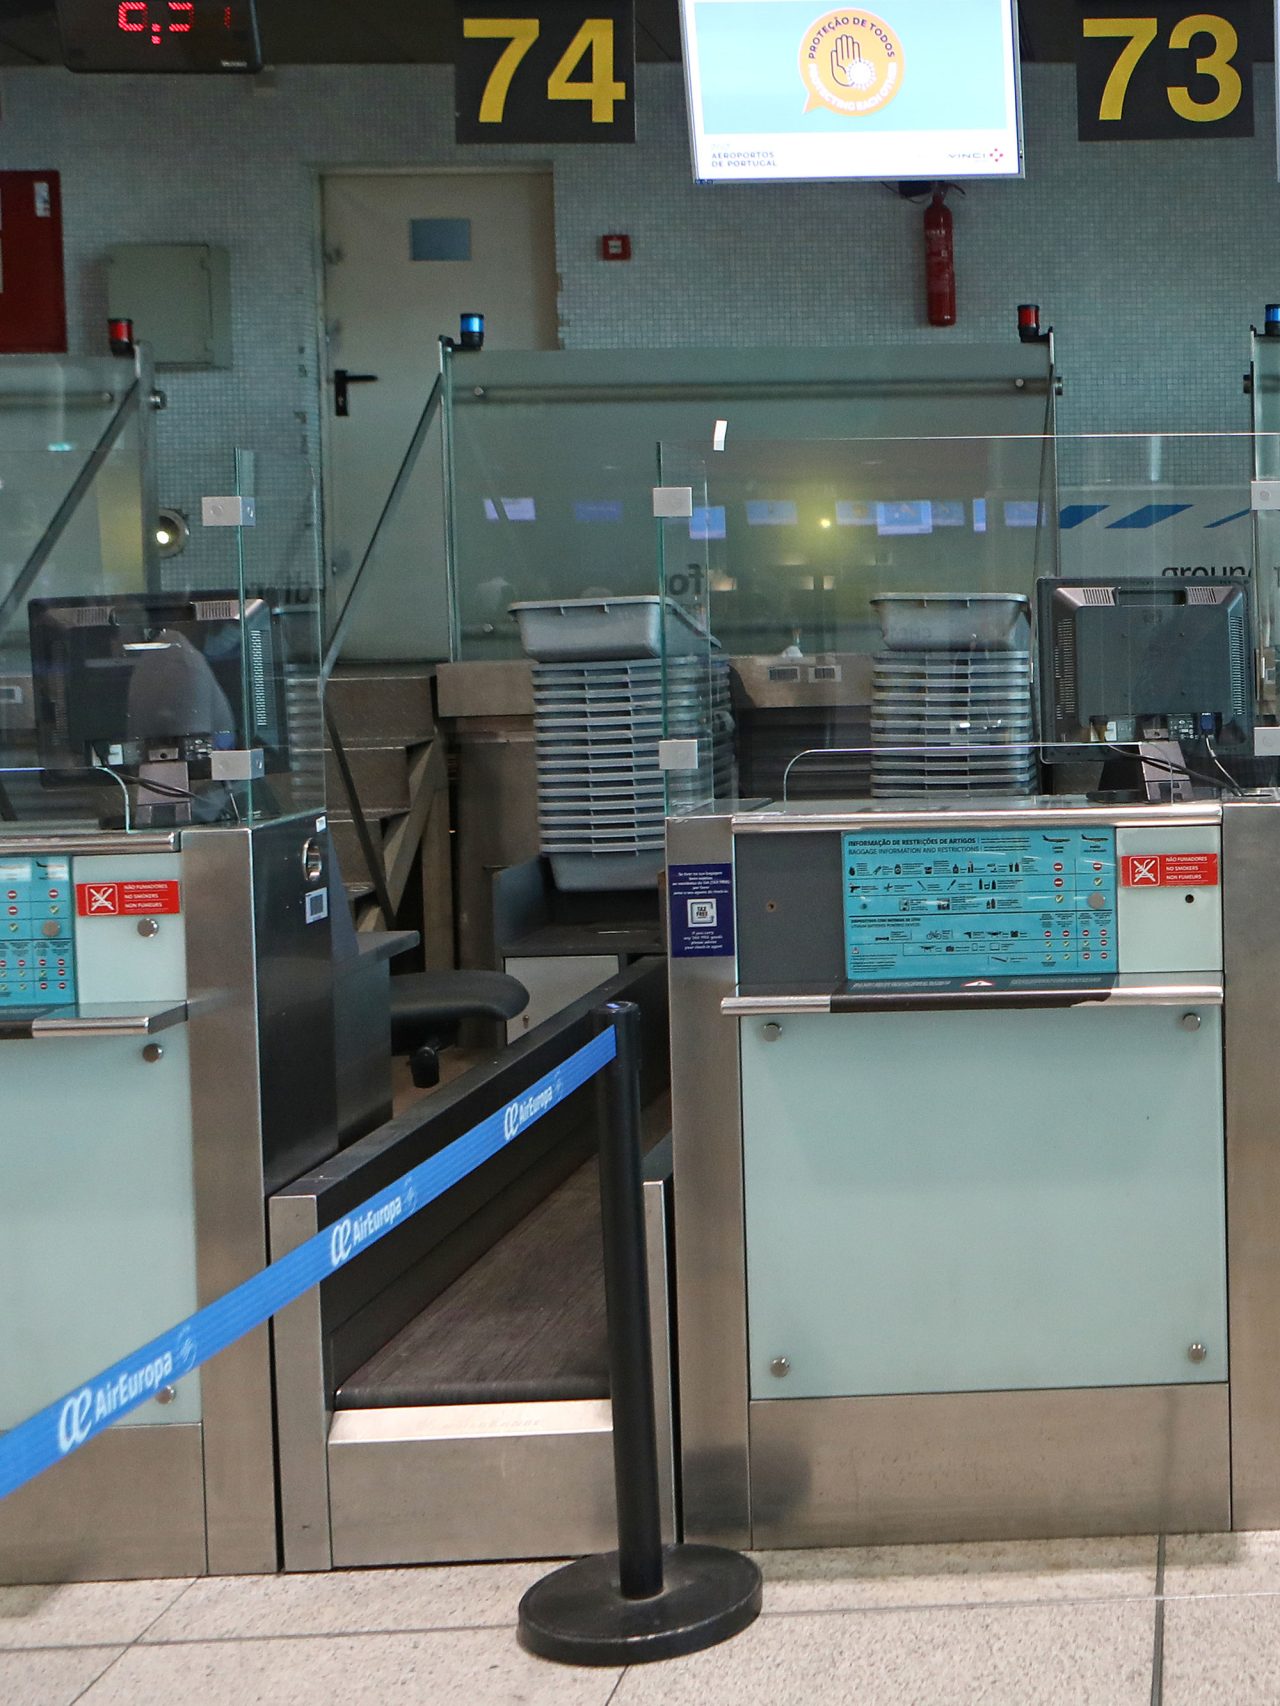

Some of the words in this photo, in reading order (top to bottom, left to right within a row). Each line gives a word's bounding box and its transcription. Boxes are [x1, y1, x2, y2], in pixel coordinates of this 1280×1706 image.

[809, 16, 850, 59] PROTEÇÃO
[853, 17, 867, 27] DE
[869, 22, 895, 58] TODOS
[463, 17, 626, 123] 74
[1083, 14, 1243, 122] 73
[711, 151, 775, 160] AEROPORTOS
[711, 160, 723, 168] DE
[727, 159, 777, 168] PORTUGAL
[848, 838, 891, 847] INFORMAÇÃO
[519, 1085, 553, 1126] AirEuropa
[352, 1196, 402, 1247] AirEuropa
[95, 1350, 173, 1425] AirEuropa
